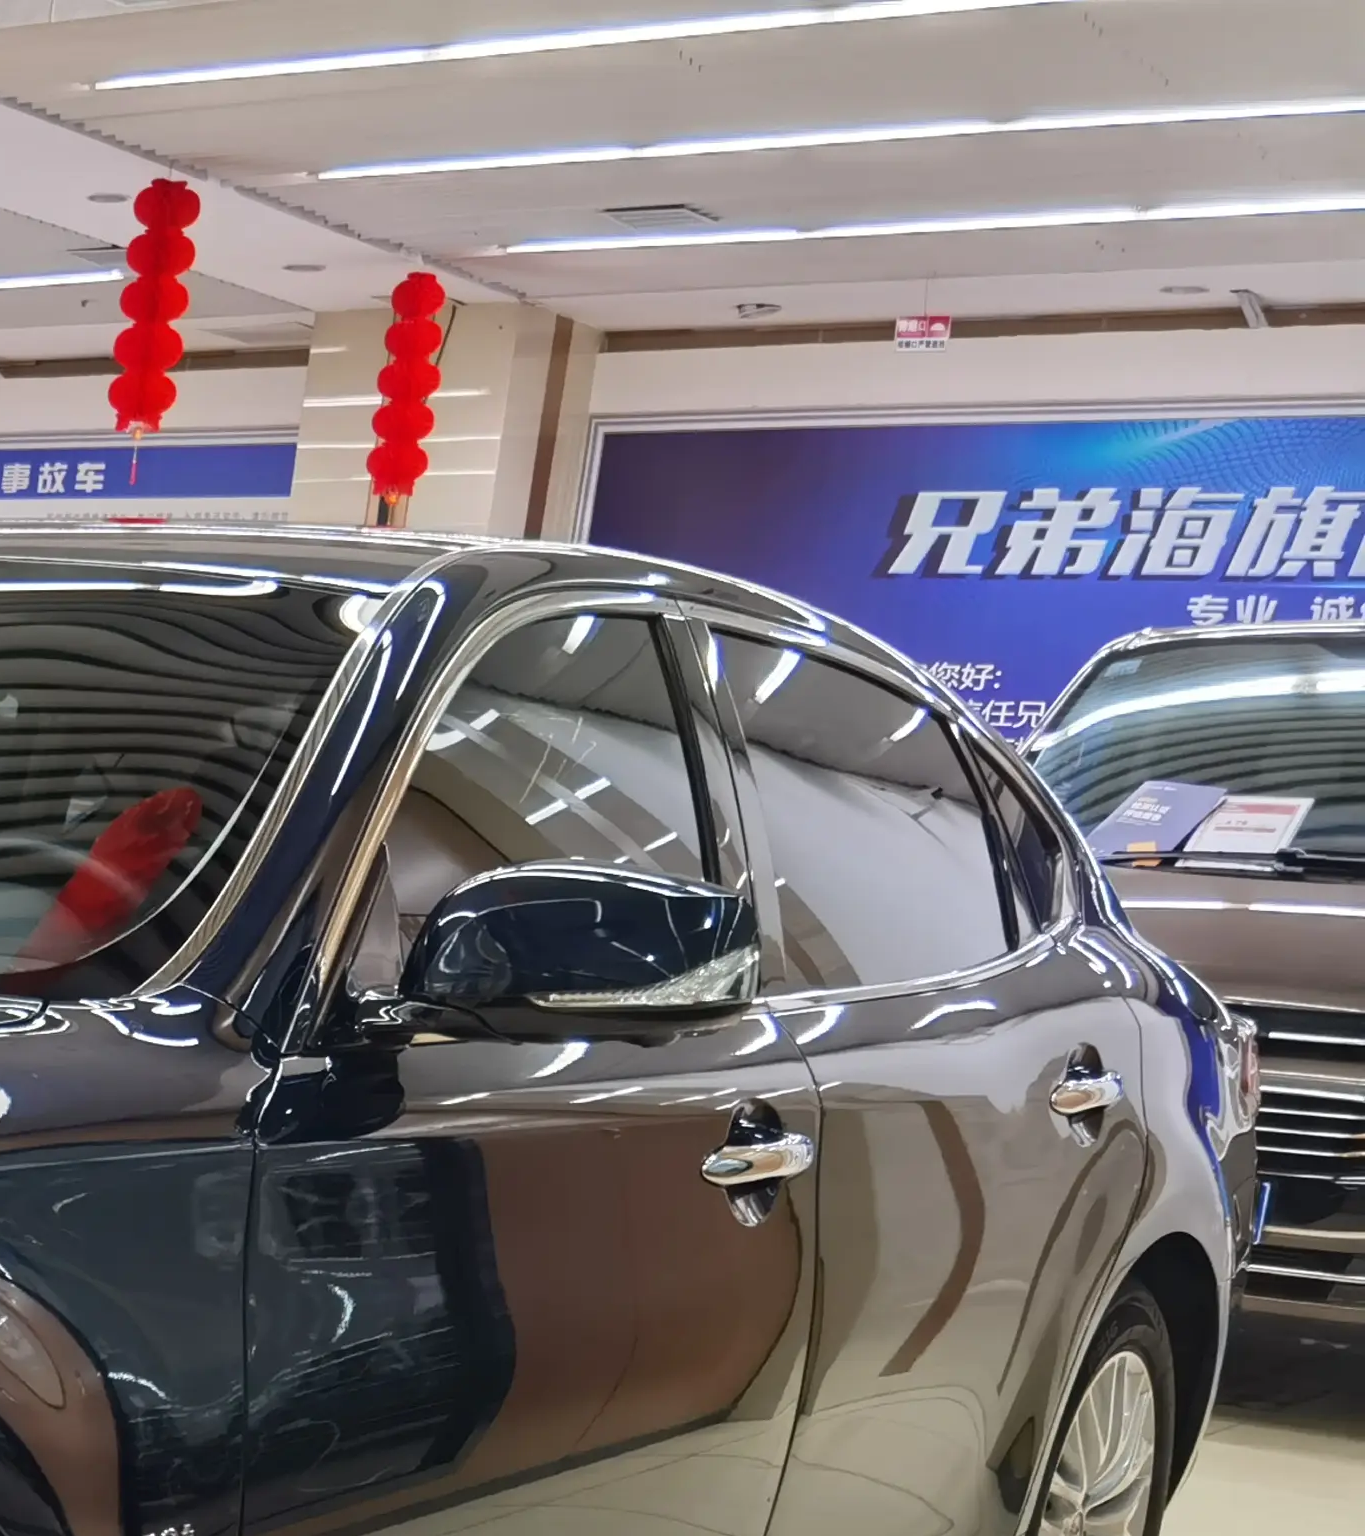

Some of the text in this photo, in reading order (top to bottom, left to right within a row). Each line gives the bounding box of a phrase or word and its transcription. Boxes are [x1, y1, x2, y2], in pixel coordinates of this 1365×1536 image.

[888, 486, 1365, 577] 兄弟海旗
[1186, 594, 1365, 625] 专业 诚
[923, 661, 1002, 691] 您好:
